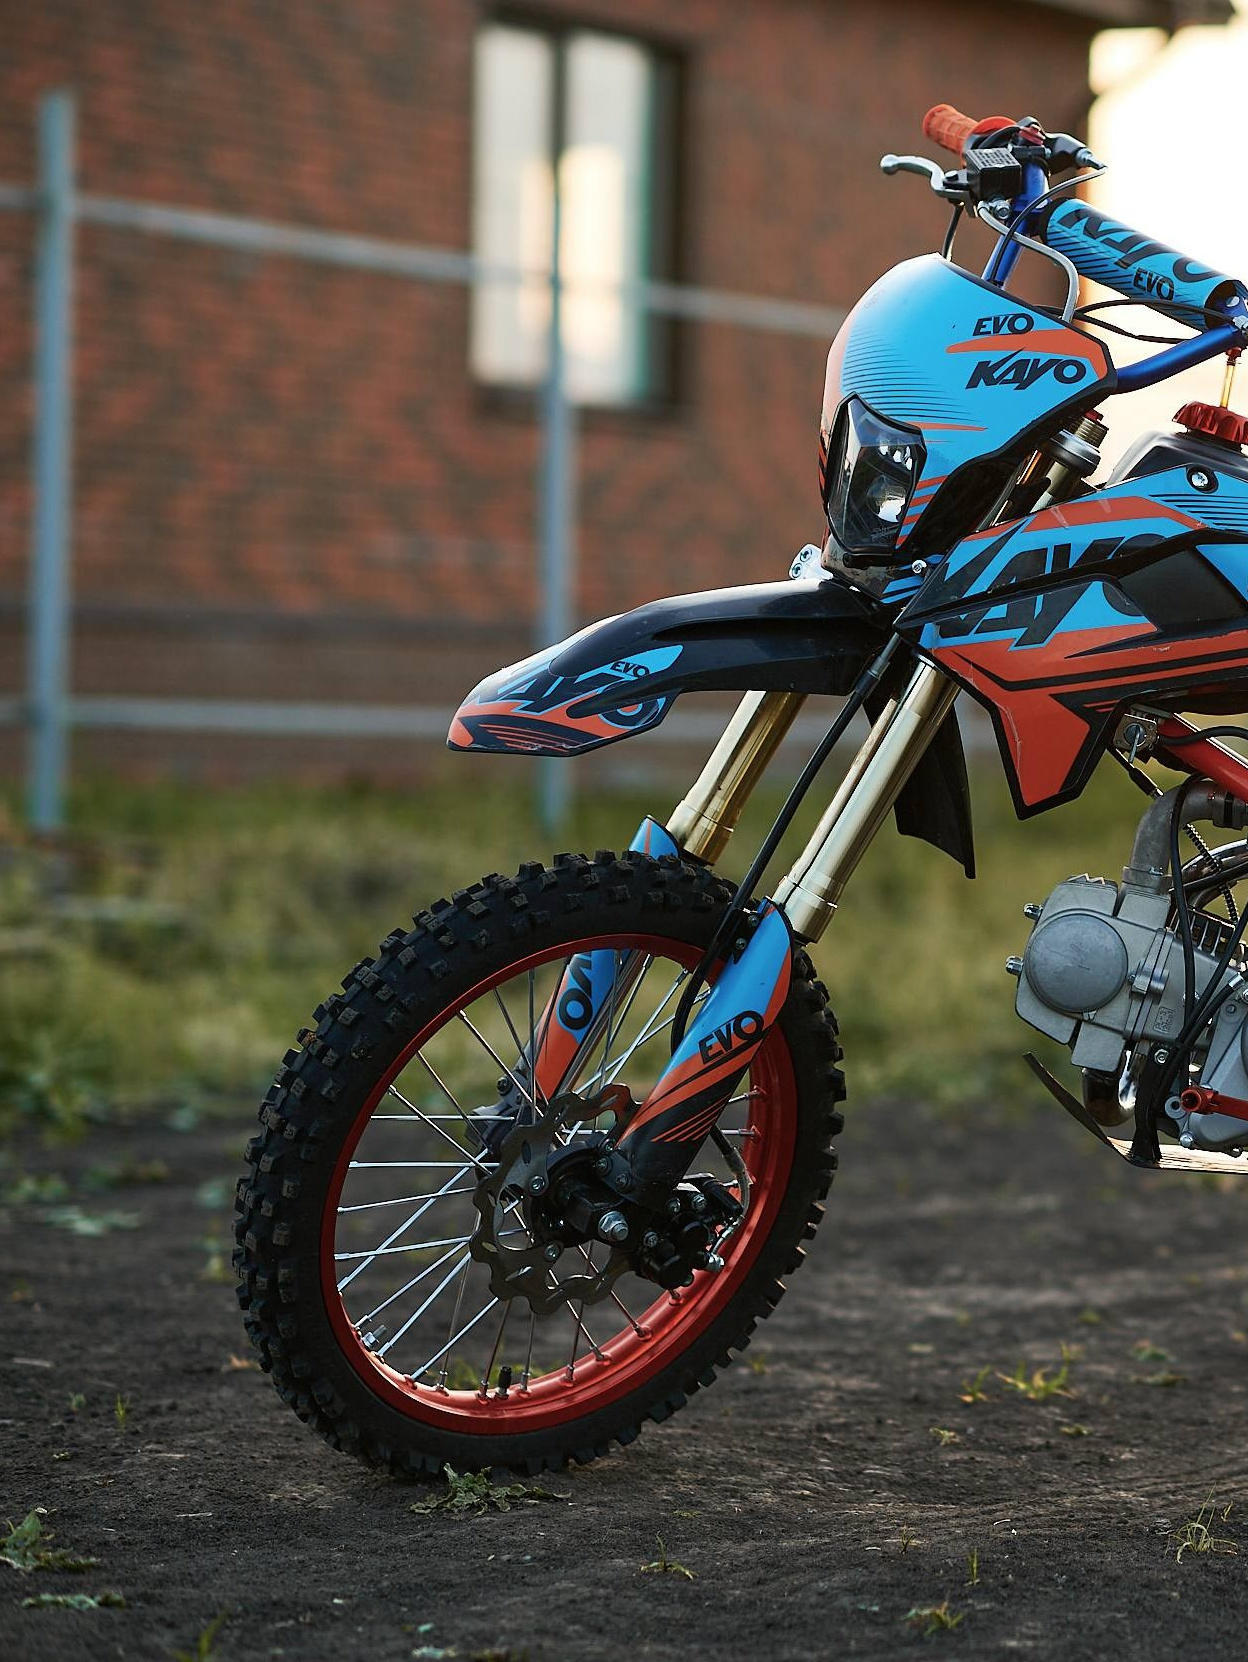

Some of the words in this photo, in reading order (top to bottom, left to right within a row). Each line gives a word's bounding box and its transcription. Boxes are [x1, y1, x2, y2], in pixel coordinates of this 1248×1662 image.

[1133, 267, 1174, 301] EVO
[973, 313, 1035, 336] EVO
[965, 347, 1087, 390] KAYO
[610, 661, 650, 678] EVO
[698, 1010, 765, 1065] EVO
